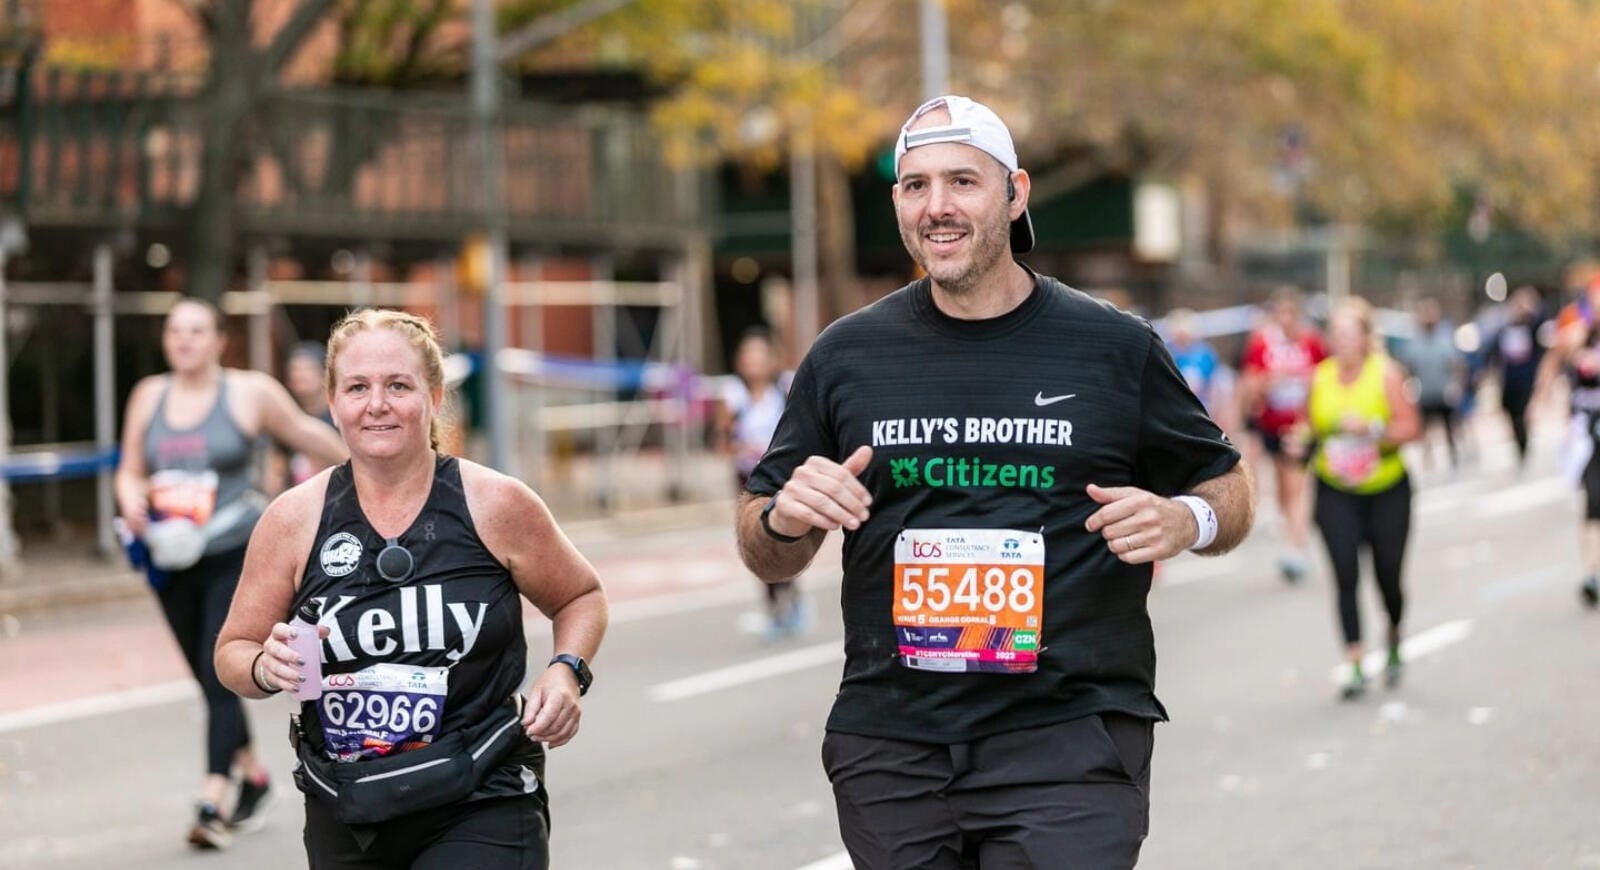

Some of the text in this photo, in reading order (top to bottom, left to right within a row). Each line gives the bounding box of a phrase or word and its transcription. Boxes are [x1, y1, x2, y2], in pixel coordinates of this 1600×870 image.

[872, 417, 1073, 447] KELLY’S BROTHER
[923, 456, 1056, 488] Citizens
[912, 539, 942, 558] tcs
[1000, 551, 1022, 559] TATA
[901, 567, 1036, 613] 55488
[311, 584, 489, 664] Kelly
[1014, 634, 1037, 645] CZN
[407, 681, 428, 689] TATA
[323, 691, 438, 734] 62966
